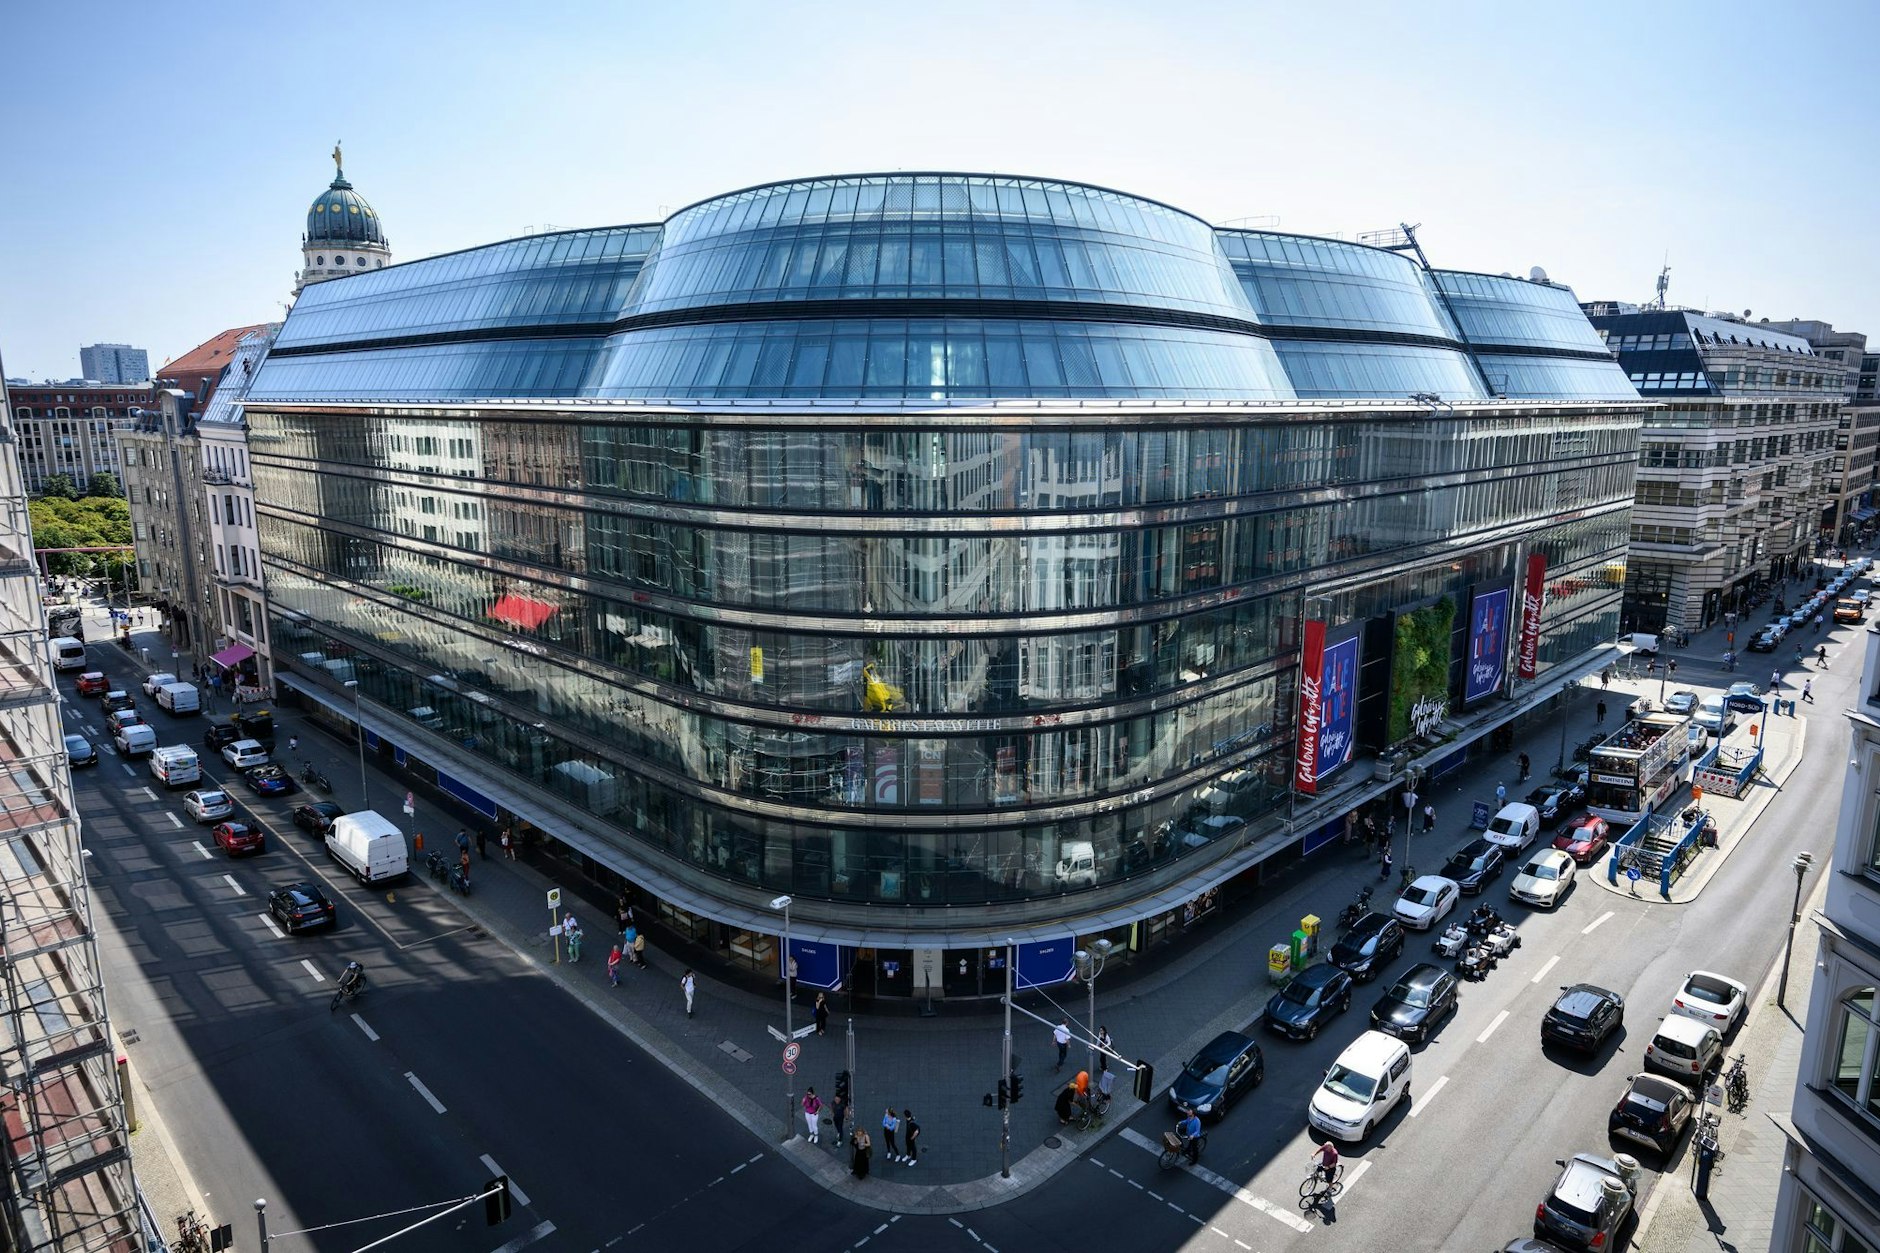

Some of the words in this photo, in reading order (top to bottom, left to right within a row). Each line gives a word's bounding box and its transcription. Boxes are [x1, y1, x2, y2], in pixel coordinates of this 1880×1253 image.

[1301, 671, 1321, 734] Lafayette
[851, 718, 918, 732] GALERIES
[923, 718, 1001, 731] LAFAYETTE
[1298, 736, 1317, 783] Galeries
[787, 1047, 797, 1058] 30
